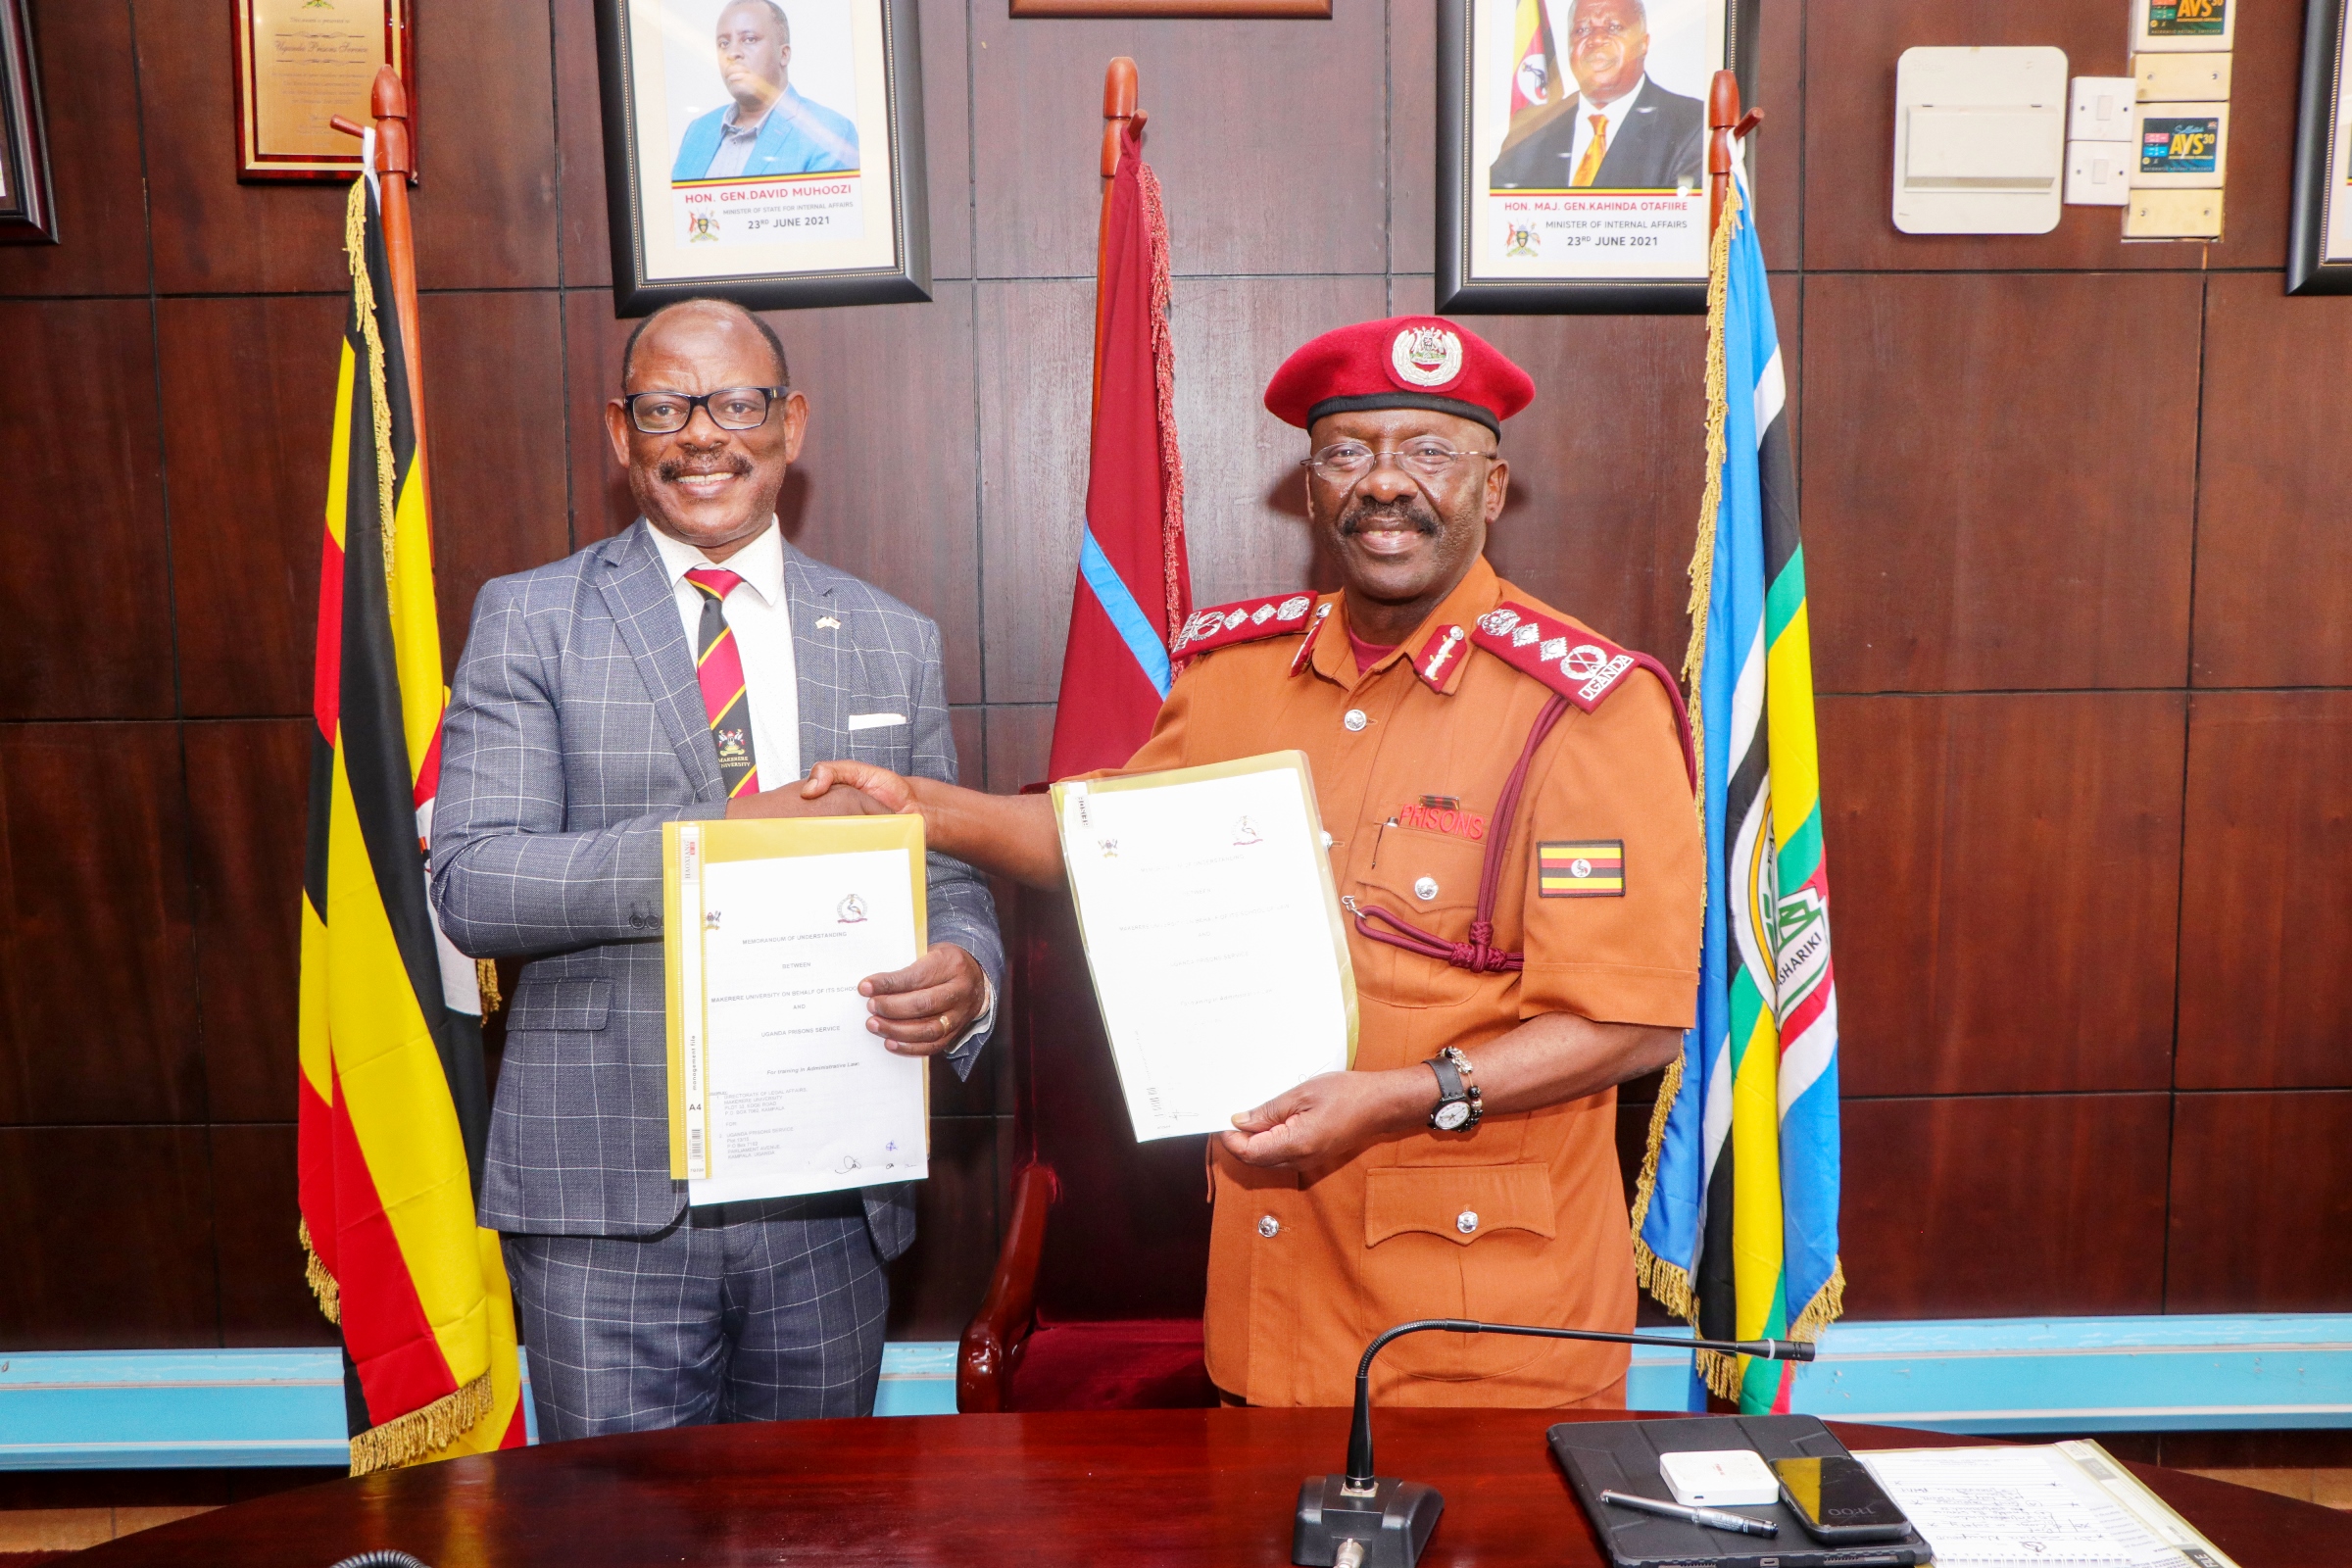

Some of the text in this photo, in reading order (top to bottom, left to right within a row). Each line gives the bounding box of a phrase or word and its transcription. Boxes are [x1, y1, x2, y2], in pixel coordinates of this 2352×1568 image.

[685, 184, 852, 204] HON. GEN.DAVID MUHOOZI
[723, 207, 751, 215] MINISTER
[1504, 202, 1531, 211] HON.
[1535, 201, 1561, 211] MAJ.
[1641, 201, 1688, 211] OTAFIIRE
[773, 218, 801, 228] JUNE
[805, 216, 830, 226] 2021
[1595, 237, 1625, 246] JUNE
[1630, 236, 1658, 246] 2021
[1578, 655, 1634, 701] UGANDA
[1399, 804, 1485, 839] PRISONS
[742, 936, 786, 945] MEMORANDUM
[797, 932, 847, 941] UNDERSTANDING
[746, 992, 780, 1000] UNIVERSITY
[807, 1063, 846, 1071] Administrative
[689, 1102, 702, 1112] A4
[1827, 1507, 1875, 1516] 11:00
[2194, 1554, 2218, 1568] FILE
